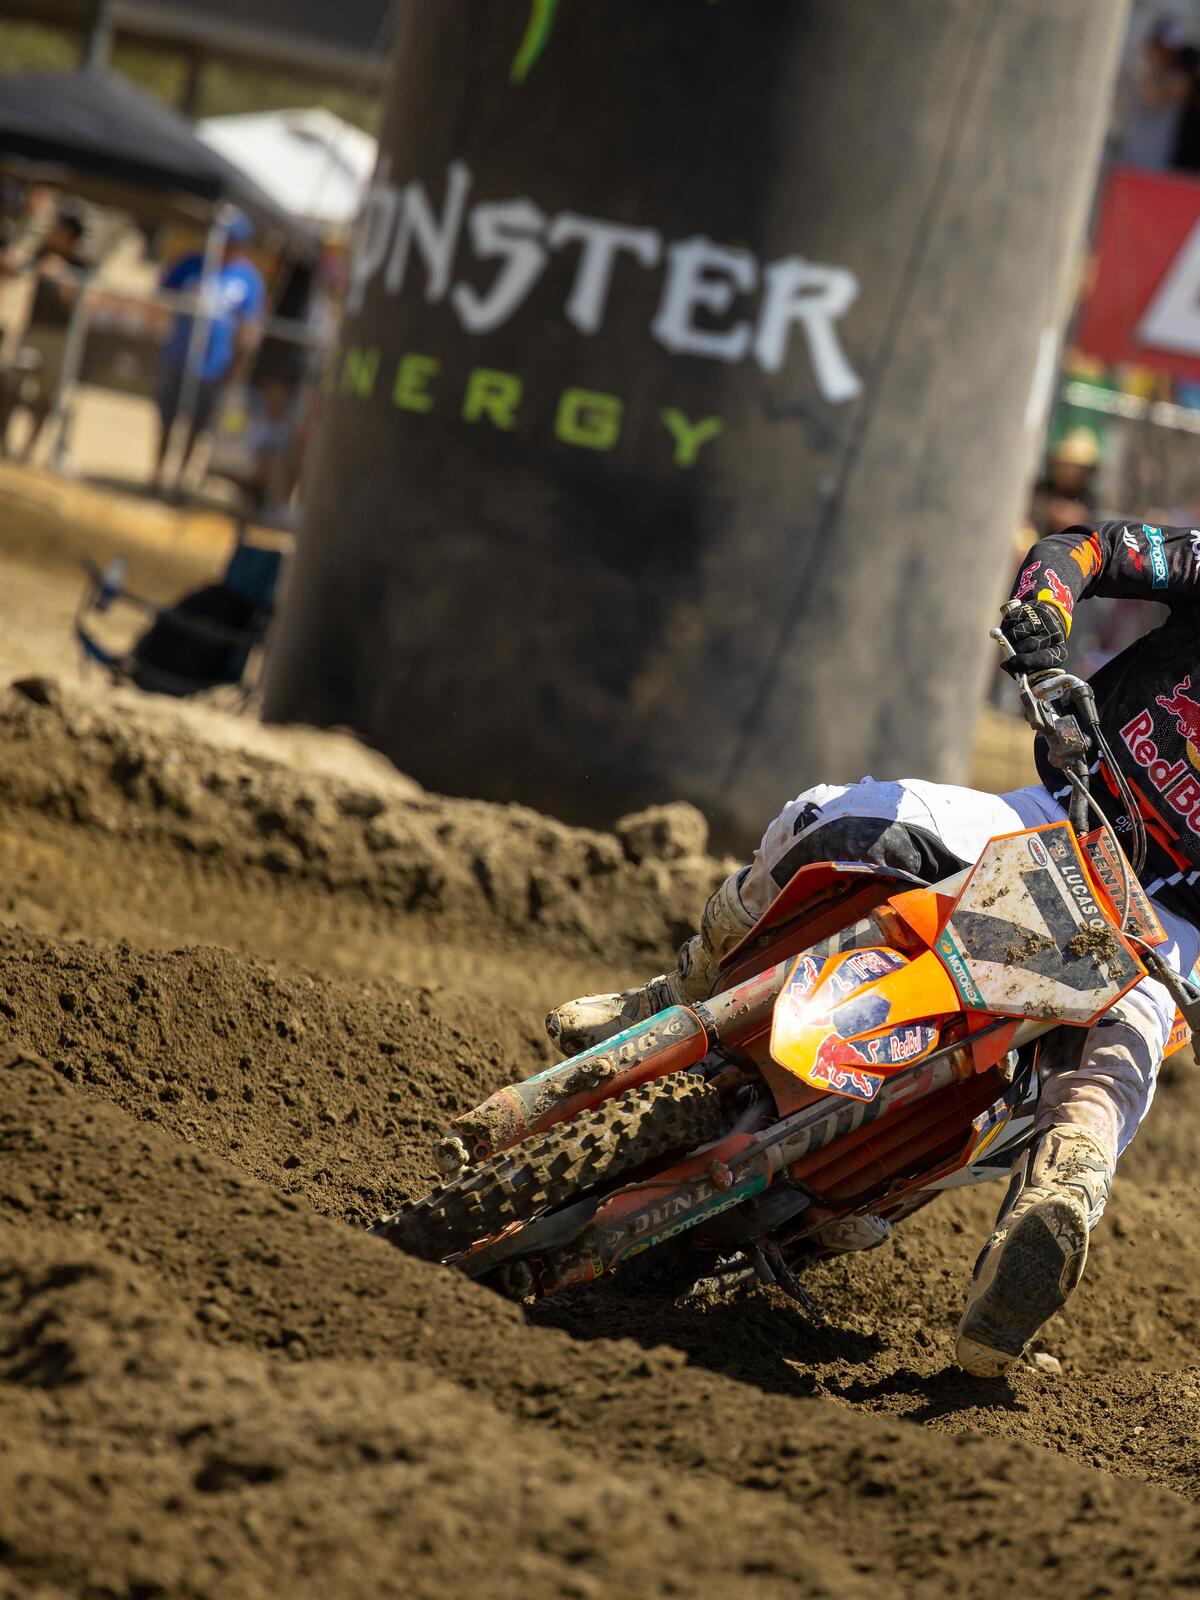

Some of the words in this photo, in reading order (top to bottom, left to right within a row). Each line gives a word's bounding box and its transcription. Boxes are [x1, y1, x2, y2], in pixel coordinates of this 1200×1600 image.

[346, 156, 862, 403] ONSTER
[341, 346, 724, 468] NERGY
[1021, 603, 1042, 625] THOR
[1060, 865, 1098, 916] LUCAS
[947, 955, 979, 1006] MOTOREX
[651, 1193, 747, 1245] MOTOREX
